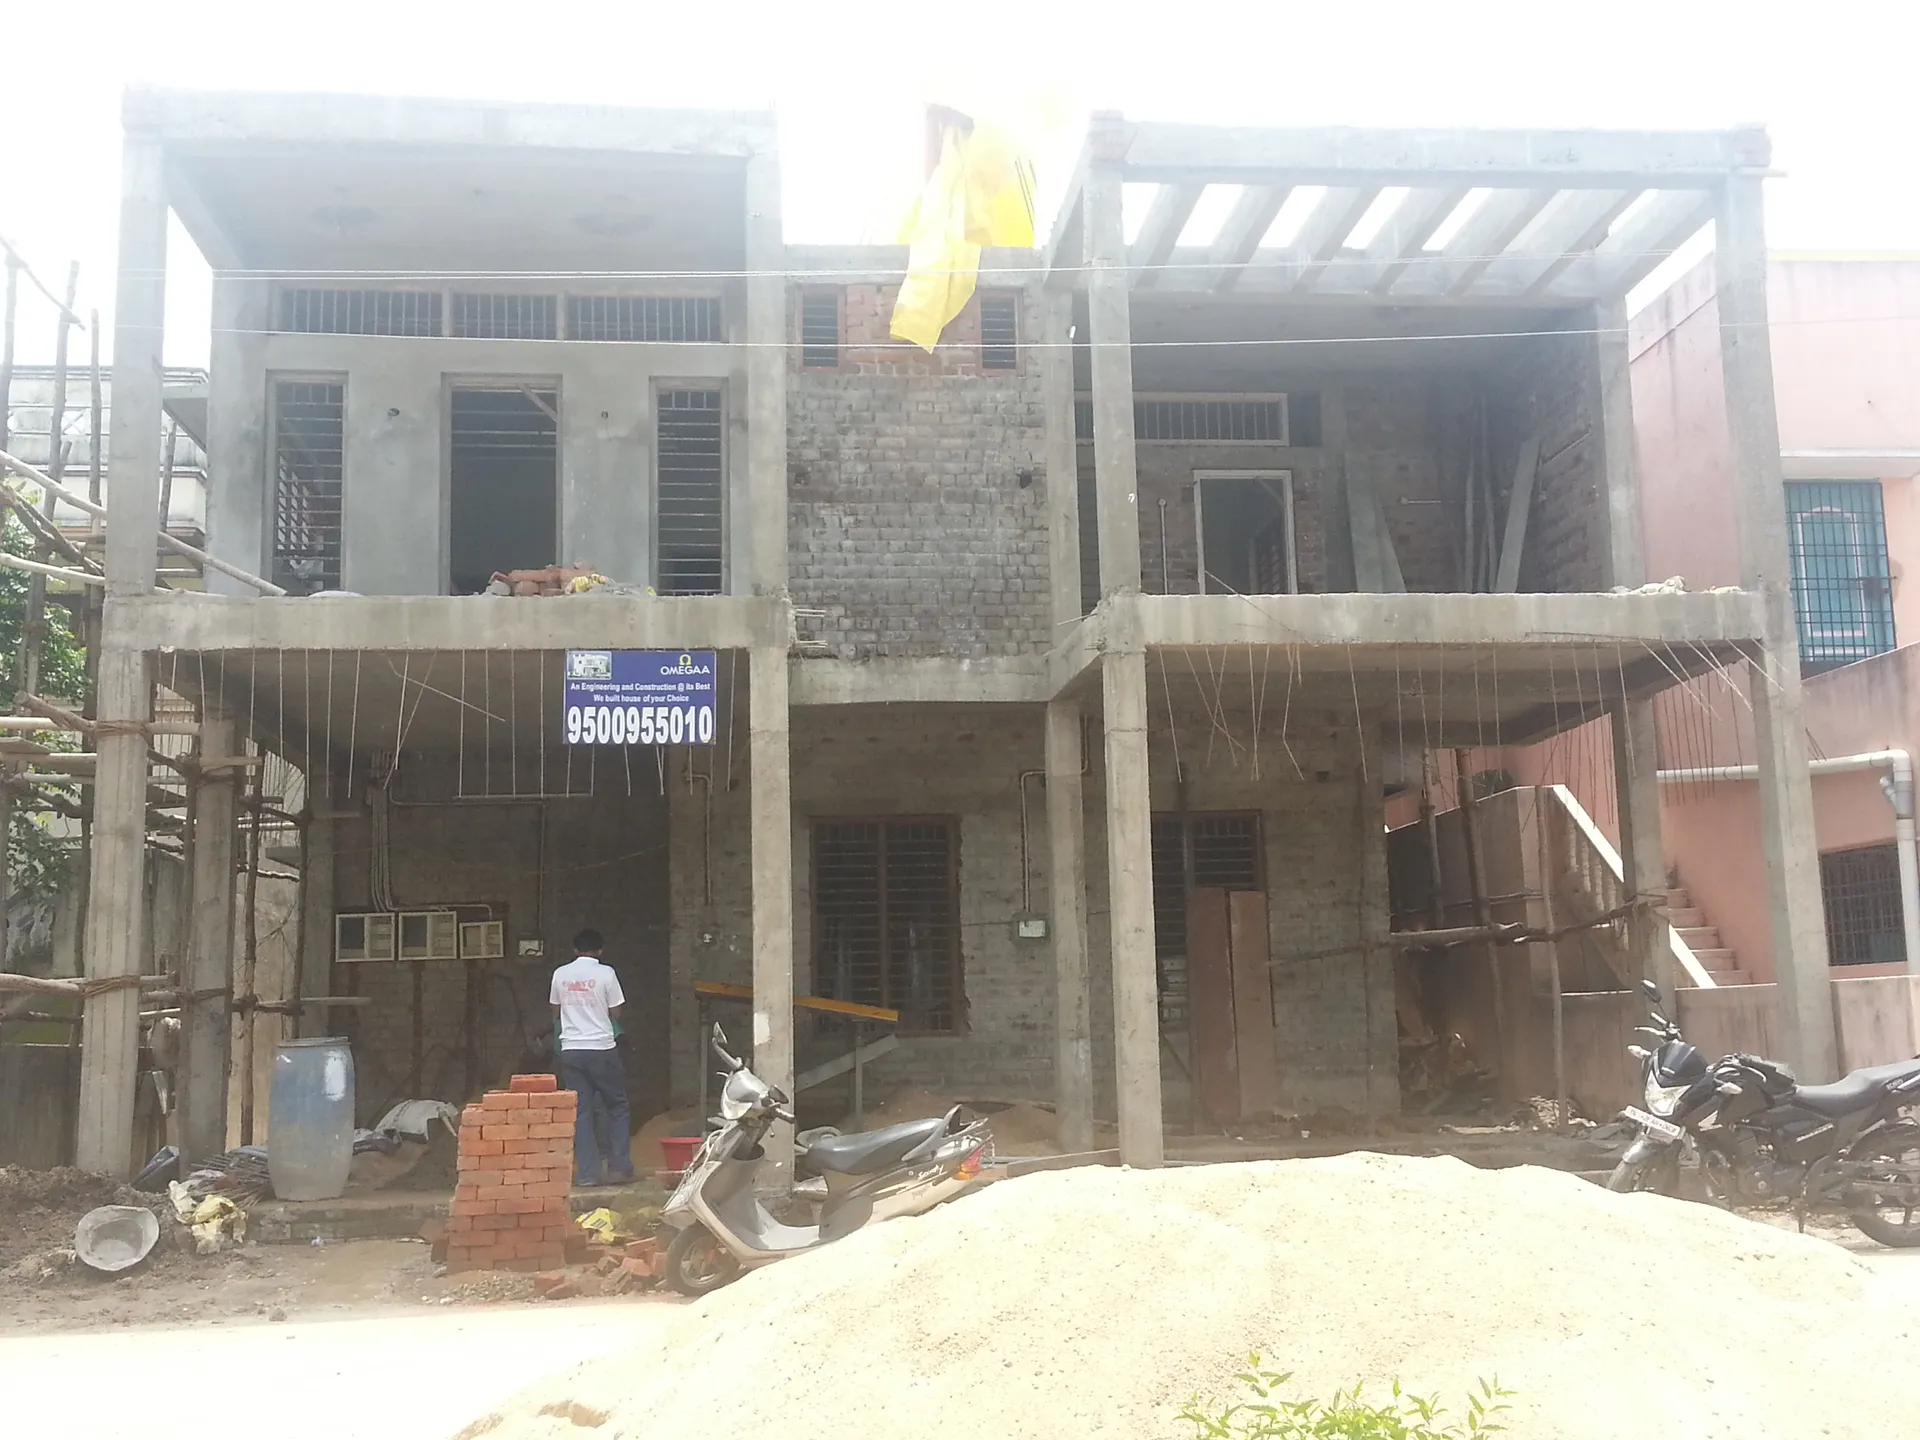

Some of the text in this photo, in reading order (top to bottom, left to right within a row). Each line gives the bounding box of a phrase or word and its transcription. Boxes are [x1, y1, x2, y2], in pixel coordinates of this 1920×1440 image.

[660, 665, 711, 676] OMEGAA
[570, 683, 581, 691] An
[582, 683, 620, 692] Engineering
[621, 683, 634, 691] and
[635, 683, 677, 692] Construction
[695, 683, 711, 691] Best
[593, 694, 690, 704] We built house of your Choice
[567, 705, 713, 744] 9500955010
